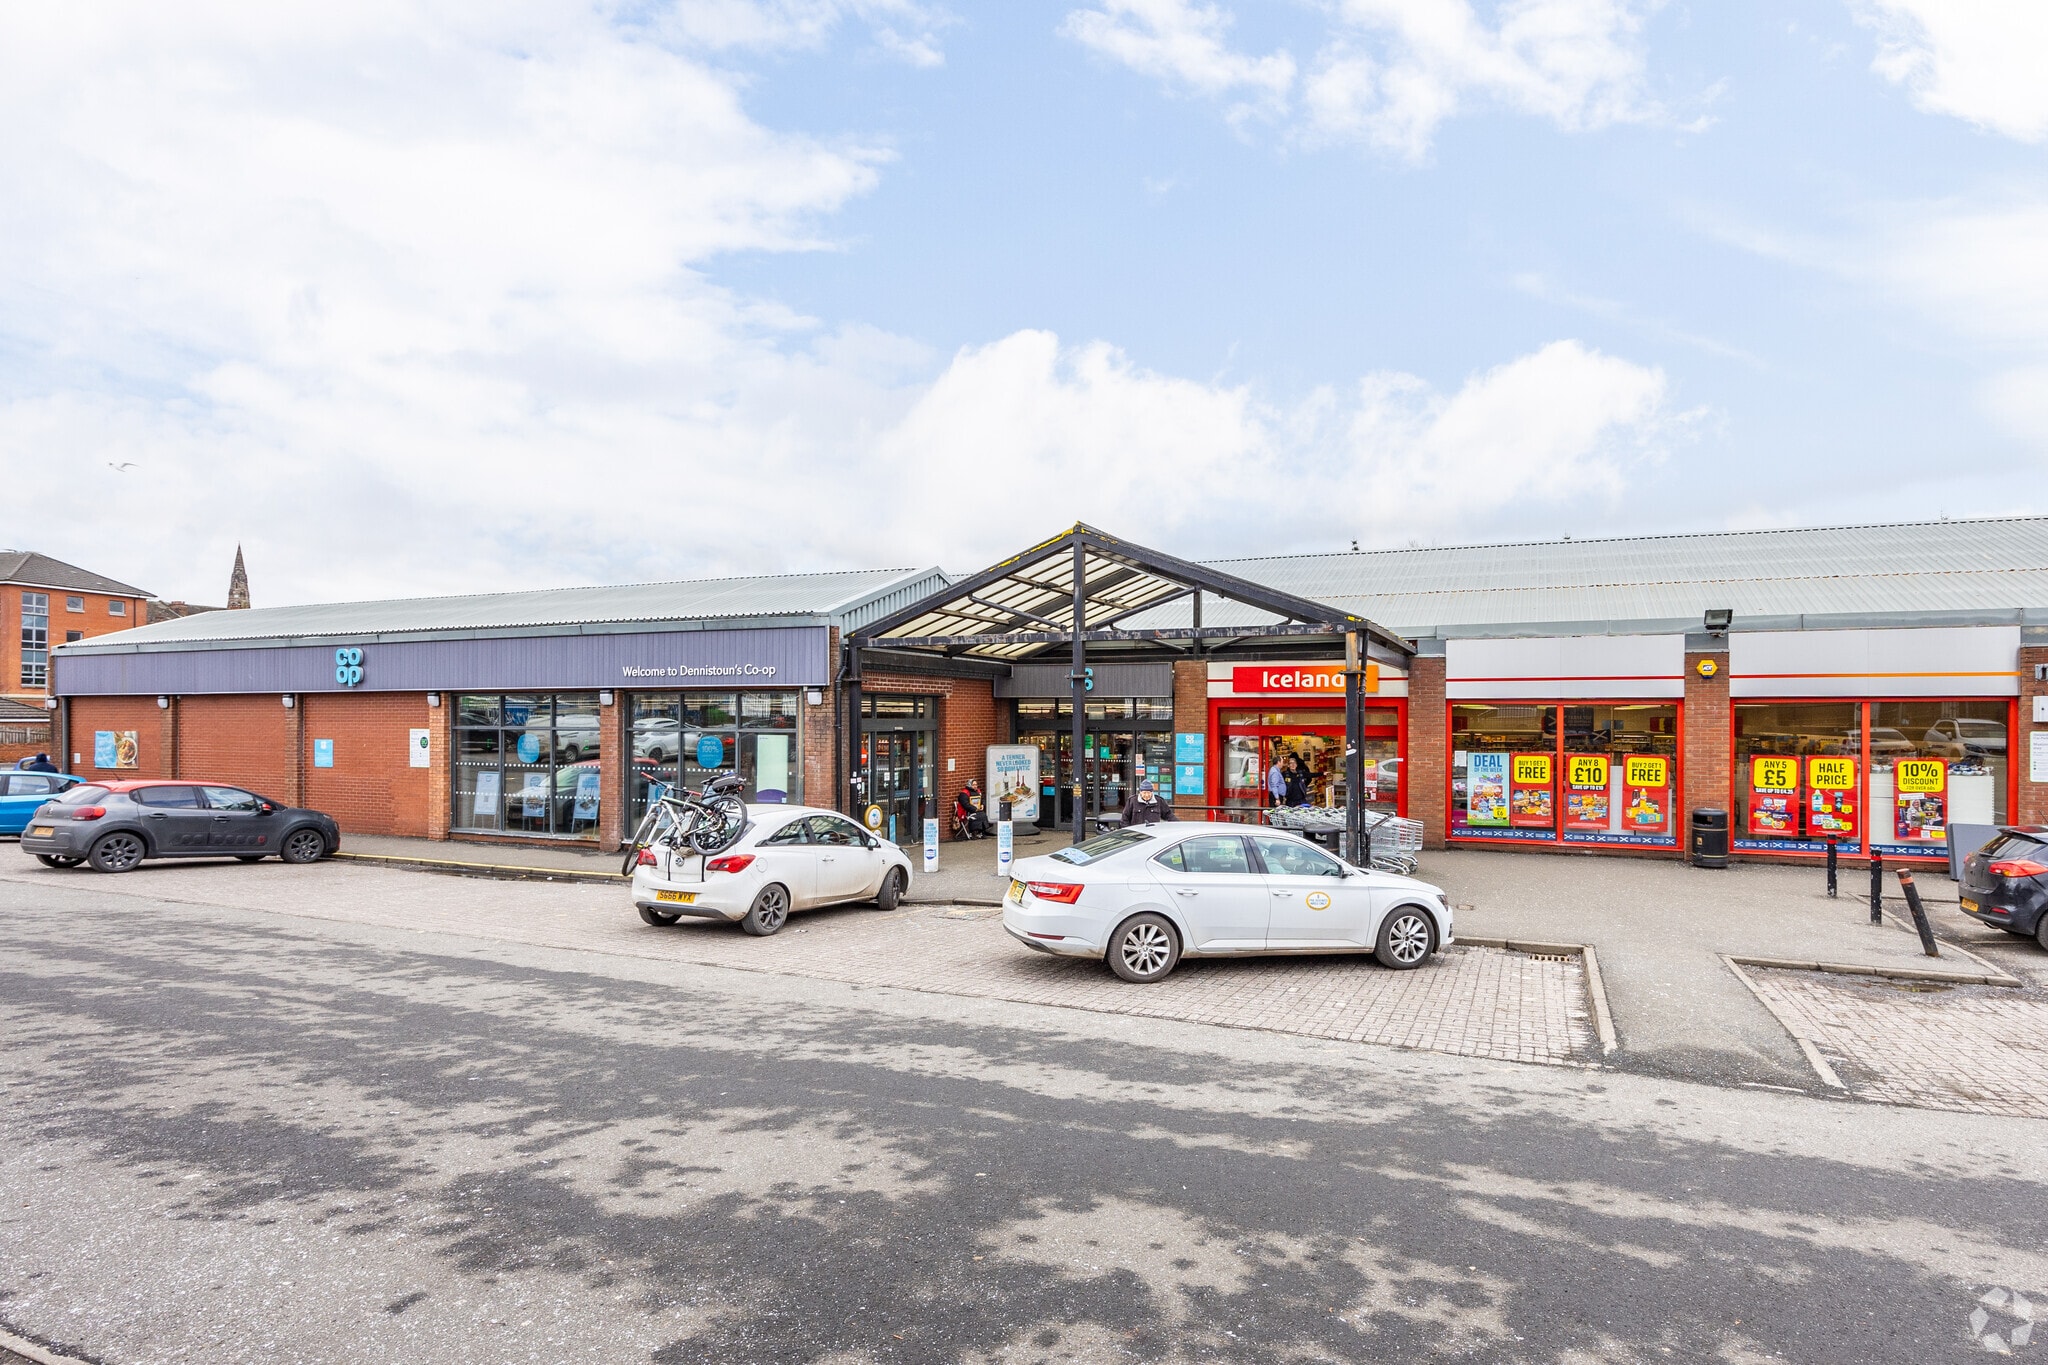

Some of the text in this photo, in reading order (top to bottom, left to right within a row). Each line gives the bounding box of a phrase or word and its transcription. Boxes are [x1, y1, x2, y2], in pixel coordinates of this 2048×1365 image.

[622, 663, 777, 678] Welcome to Dennistoun's Co-op
[1262, 670, 1345, 688] Iceland
[1474, 755, 1502, 767] DEAL
[1782, 761, 1787, 769] 5
[1518, 767, 1546, 778] FREE
[1819, 763, 1845, 773] HALF
[1903, 763, 1938, 777] 10%
[1575, 767, 1602, 783] £10
[1631, 769, 1661, 781] FREE
[1764, 770, 1787, 786] £5
[1816, 775, 1847, 785] PRICE
